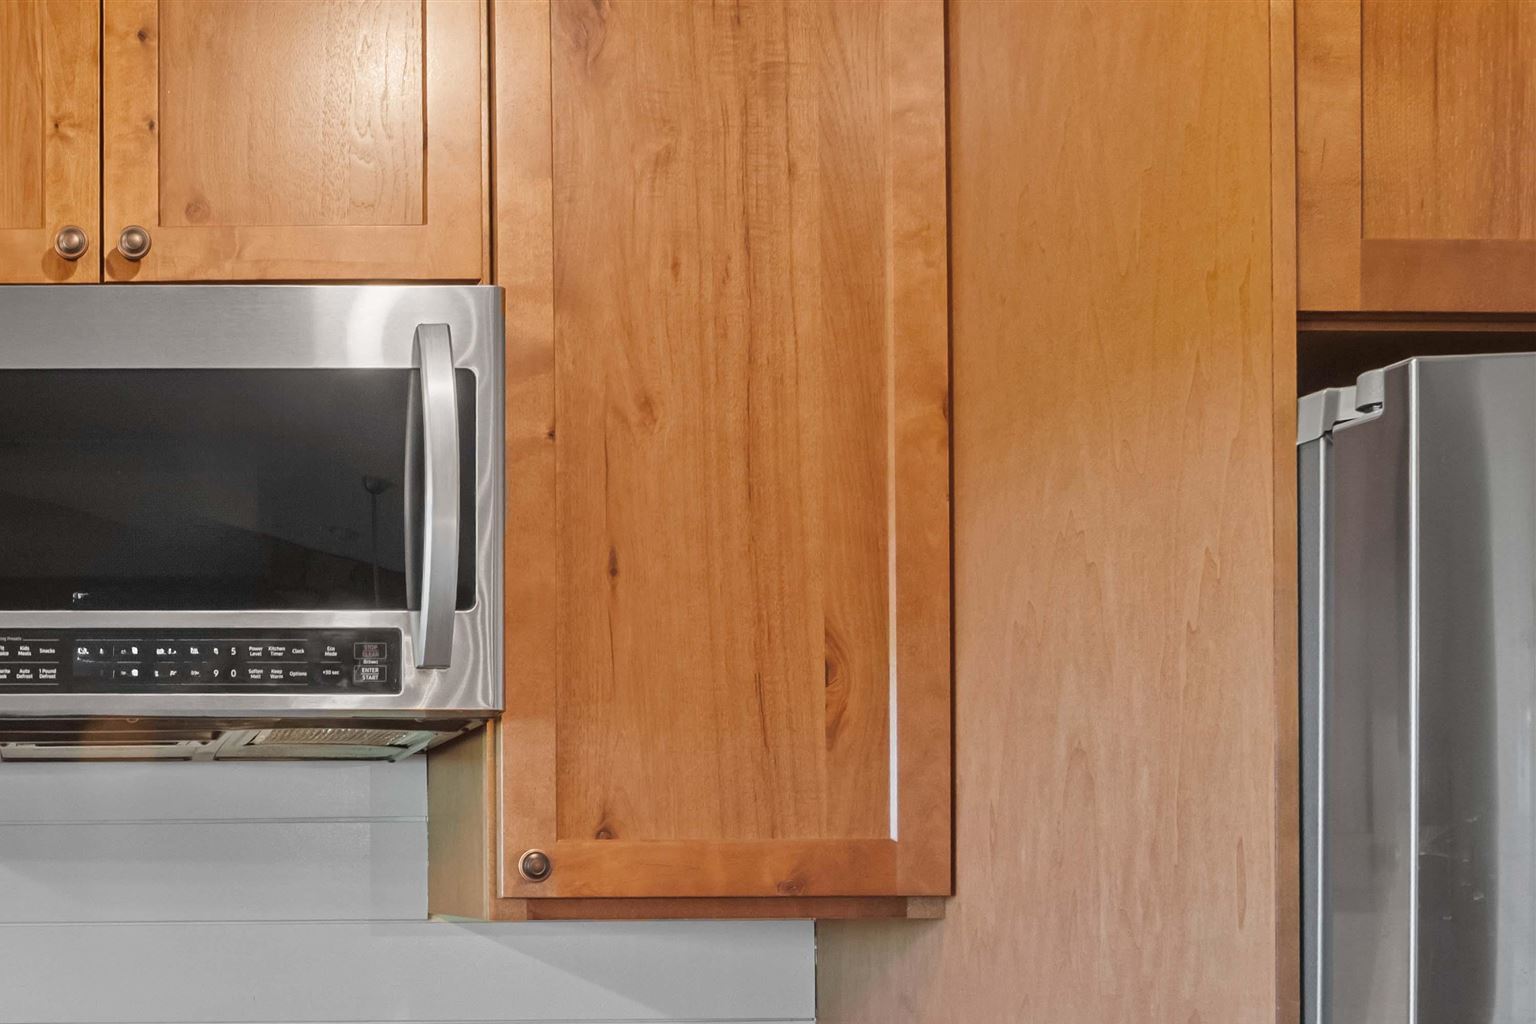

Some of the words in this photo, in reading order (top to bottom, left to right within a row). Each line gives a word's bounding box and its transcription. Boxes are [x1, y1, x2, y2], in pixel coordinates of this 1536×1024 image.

[231, 647, 237, 656] 5
[213, 669, 219, 677] 9
[231, 669, 237, 678] 0
